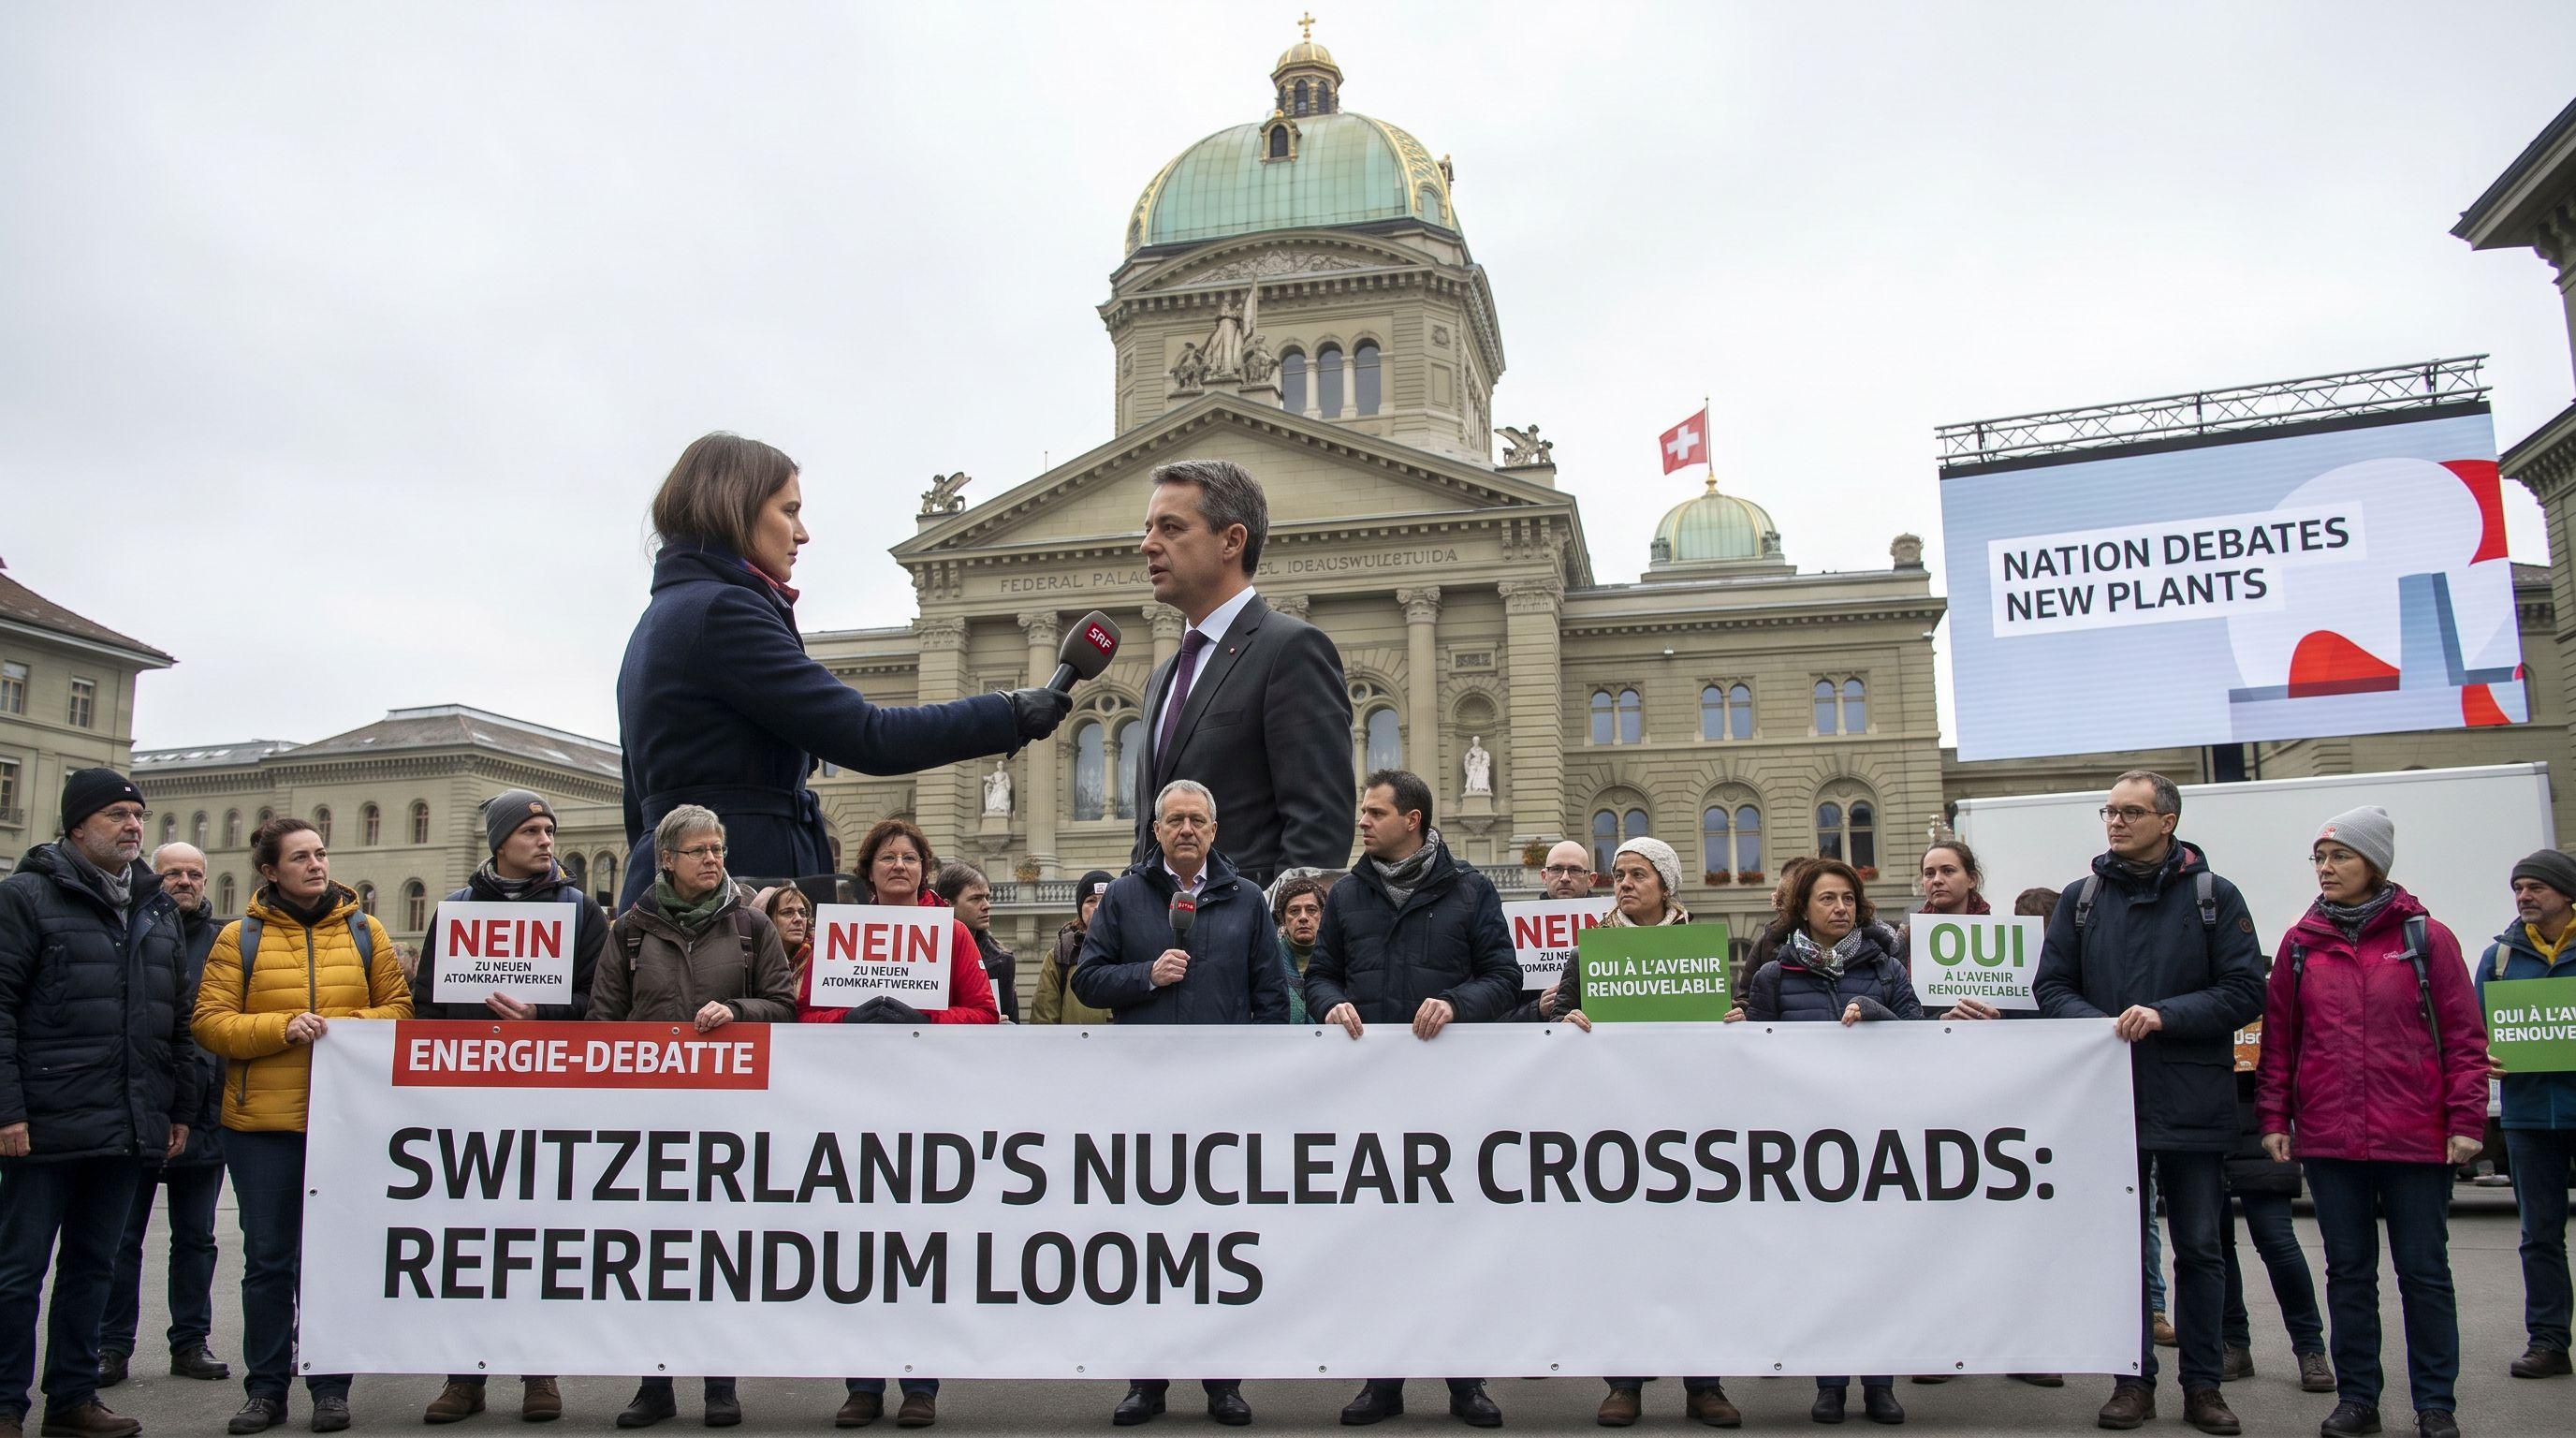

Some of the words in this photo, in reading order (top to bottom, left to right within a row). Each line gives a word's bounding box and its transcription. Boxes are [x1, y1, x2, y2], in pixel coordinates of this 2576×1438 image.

[2003, 537, 2150, 581] NATION
[2163, 517, 2349, 565] DEBATES
[1000, 575, 1084, 593] FEDERAL
[1092, 570, 1150, 586] PALAC
[2006, 584, 2095, 622] NEW
[2107, 567, 2268, 613] PLANTS
[1089, 627, 1112, 648] SRF
[449, 919, 562, 958] NEIN
[827, 922, 939, 963] NEIN
[1929, 922, 2024, 967] OUI
[1540, 951, 1554, 961] ZU
[1557, 951, 1571, 961] NE
[475, 961, 490, 971] ZU
[493, 961, 532, 972] NEUEN
[853, 965, 868, 976] ZU
[871, 966, 909, 976] NEUEN
[1588, 961, 1619, 976] OUI
[1624, 957, 1637, 976] À
[1642, 957, 1721, 976] L'AVENIR
[444, 974, 562, 984] ATOMKRAFTWERKEN
[822, 976, 939, 990] ATOMKRAFTWERKEN
[1587, 977, 1726, 997] RENOUVELABLE
[1957, 972, 2013, 983] L'AVENIR
[1928, 984, 2029, 997] RENOUVELABLE
[2494, 1008, 2525, 1024] OUI
[2528, 1004, 2542, 1022] À
[2494, 1025, 2576, 1042] RENOUVE
[408, 1038, 754, 1075] ENERGIE-DEBATTE
[387, 1127, 1047, 1206] SWITZERLAND'S
[1074, 1132, 1455, 1206] NUCLEAR
[1477, 1127, 2055, 1205] CROSSROADS:
[385, 1226, 948, 1305] REFERENDUM
[976, 1231, 1264, 1306] LOOMS
